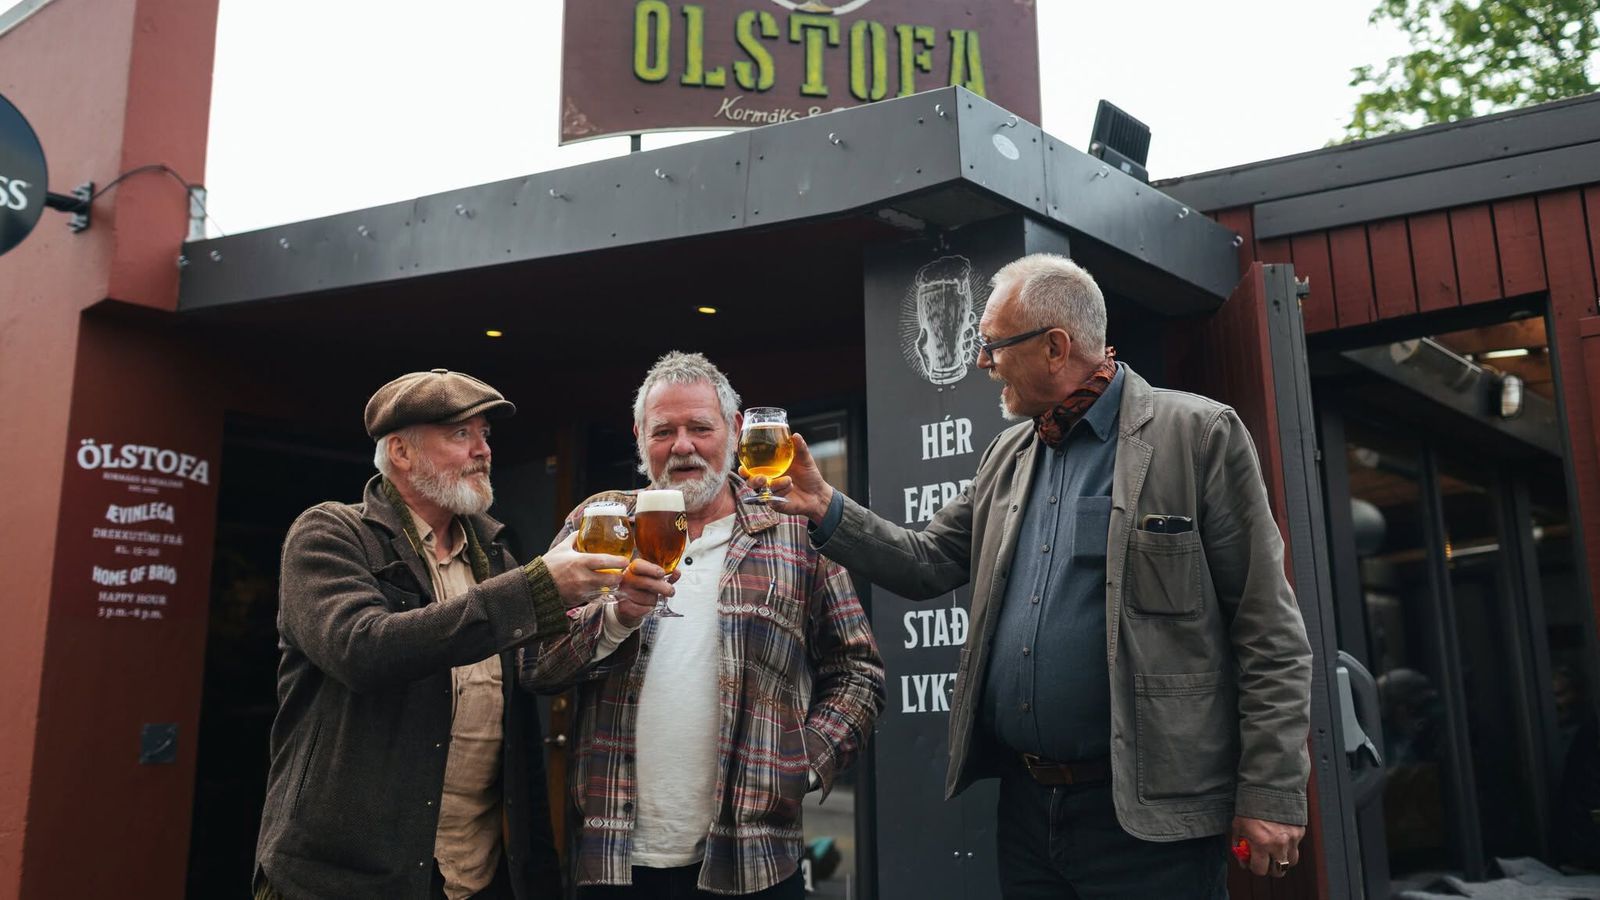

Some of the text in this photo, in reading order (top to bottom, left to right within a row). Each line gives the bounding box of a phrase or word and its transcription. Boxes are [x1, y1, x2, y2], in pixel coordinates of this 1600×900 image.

[920, 414, 974, 461] HÉR
[77, 438, 210, 485] ÖLSTOFA
[105, 502, 175, 525] ÆVINLEGA
[92, 565, 128, 587] HOME
[130, 565, 147, 584] OF
[98, 591, 167, 605] HAPPY HOUR
[903, 607, 969, 650] STAÐ
